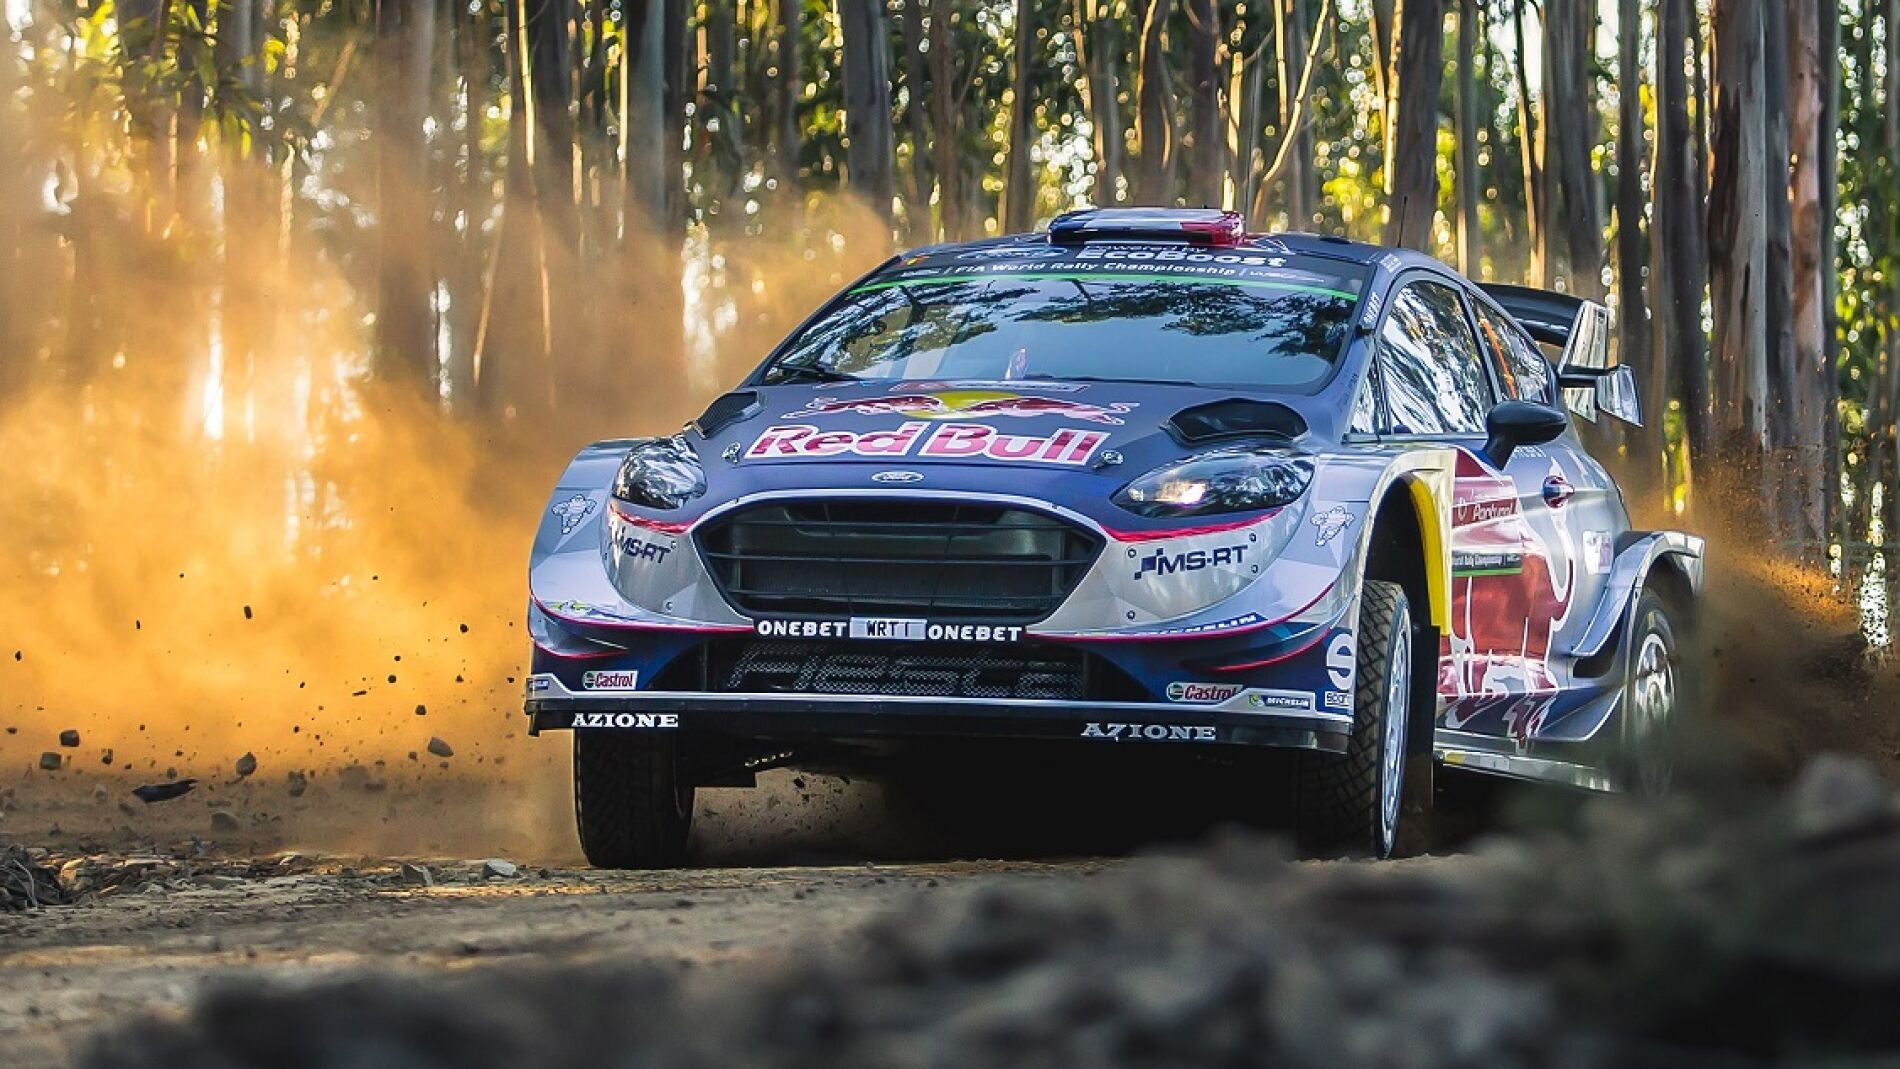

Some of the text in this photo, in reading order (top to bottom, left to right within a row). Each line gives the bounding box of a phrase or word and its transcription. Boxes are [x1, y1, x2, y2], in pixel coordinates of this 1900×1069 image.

[1075, 247, 1287, 267] EcoBoost
[955, 261, 1237, 276] FIA World Rally Championship
[744, 421, 1112, 466] Red Bull
[757, 619, 848, 637] ONEBET
[928, 624, 1022, 641] ONEBET
[594, 672, 634, 688] Castrol
[1184, 684, 1237, 701] Castrol
[571, 712, 679, 728] AZIONE
